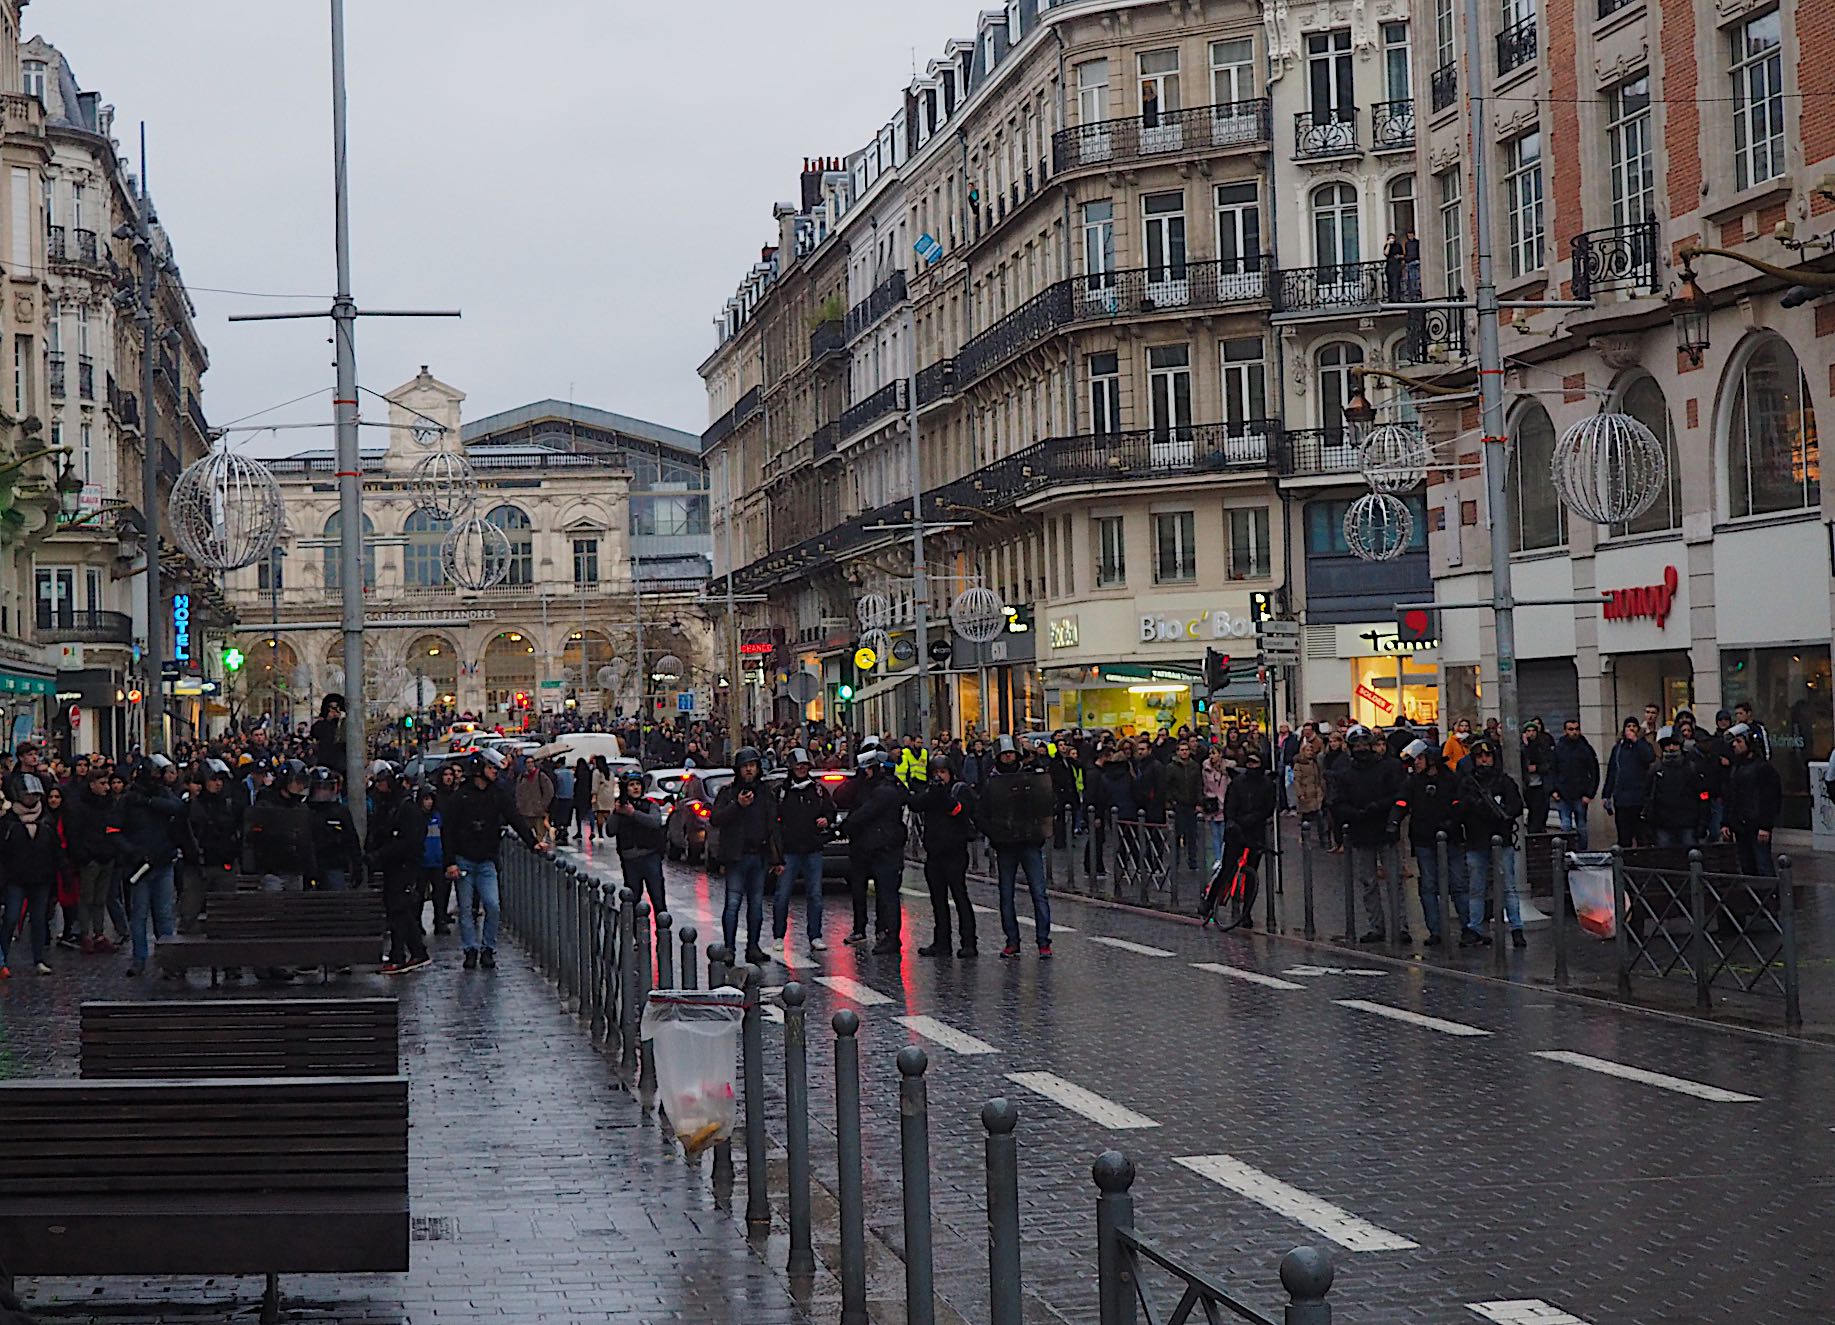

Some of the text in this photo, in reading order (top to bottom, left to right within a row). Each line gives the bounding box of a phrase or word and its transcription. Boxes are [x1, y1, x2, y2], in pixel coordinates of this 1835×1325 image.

[174, 594, 190, 661] HOTEL
[364, 609, 497, 621] GARE DE LILLE FLANDRES
[1139, 614, 1183, 642] Bio
